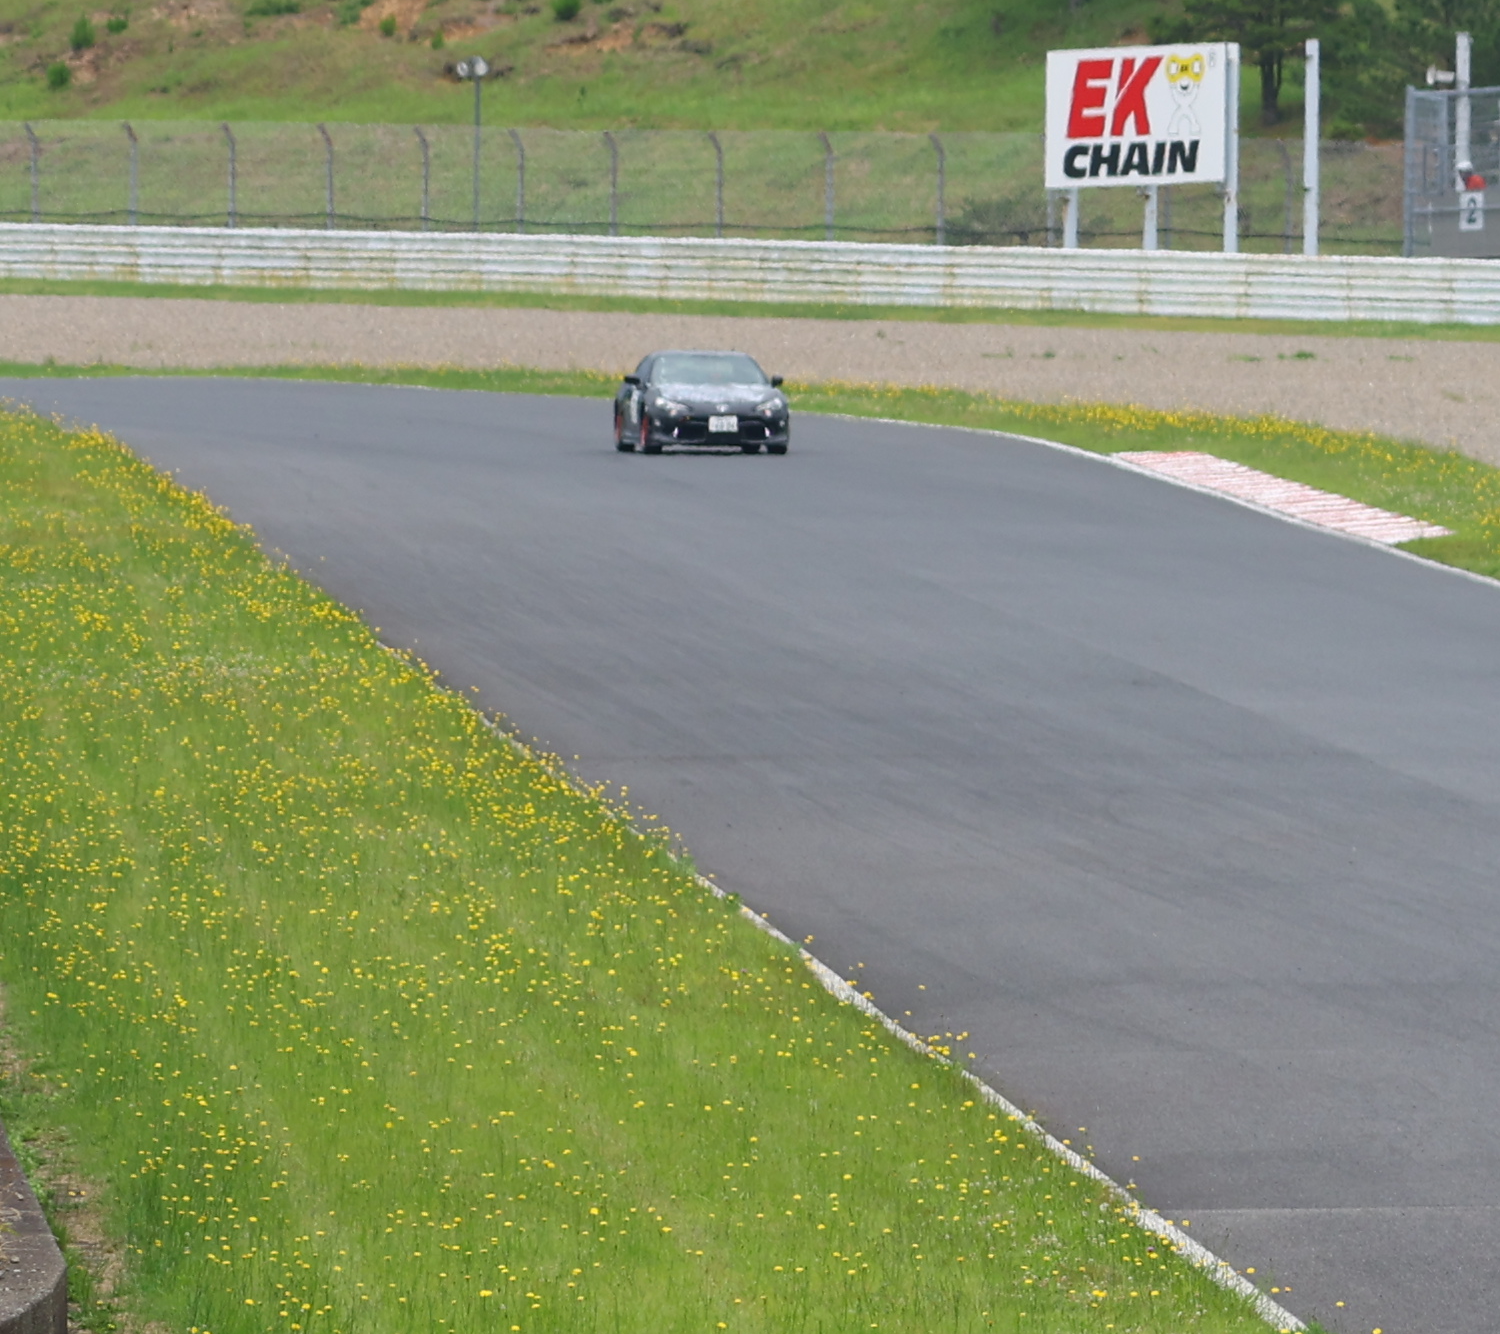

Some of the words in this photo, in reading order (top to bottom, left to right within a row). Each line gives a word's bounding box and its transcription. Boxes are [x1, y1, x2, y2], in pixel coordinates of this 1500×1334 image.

[1066, 56, 1164, 139] EK
[1063, 139, 1200, 178] CHAIN
[1467, 197, 1477, 224] 2
